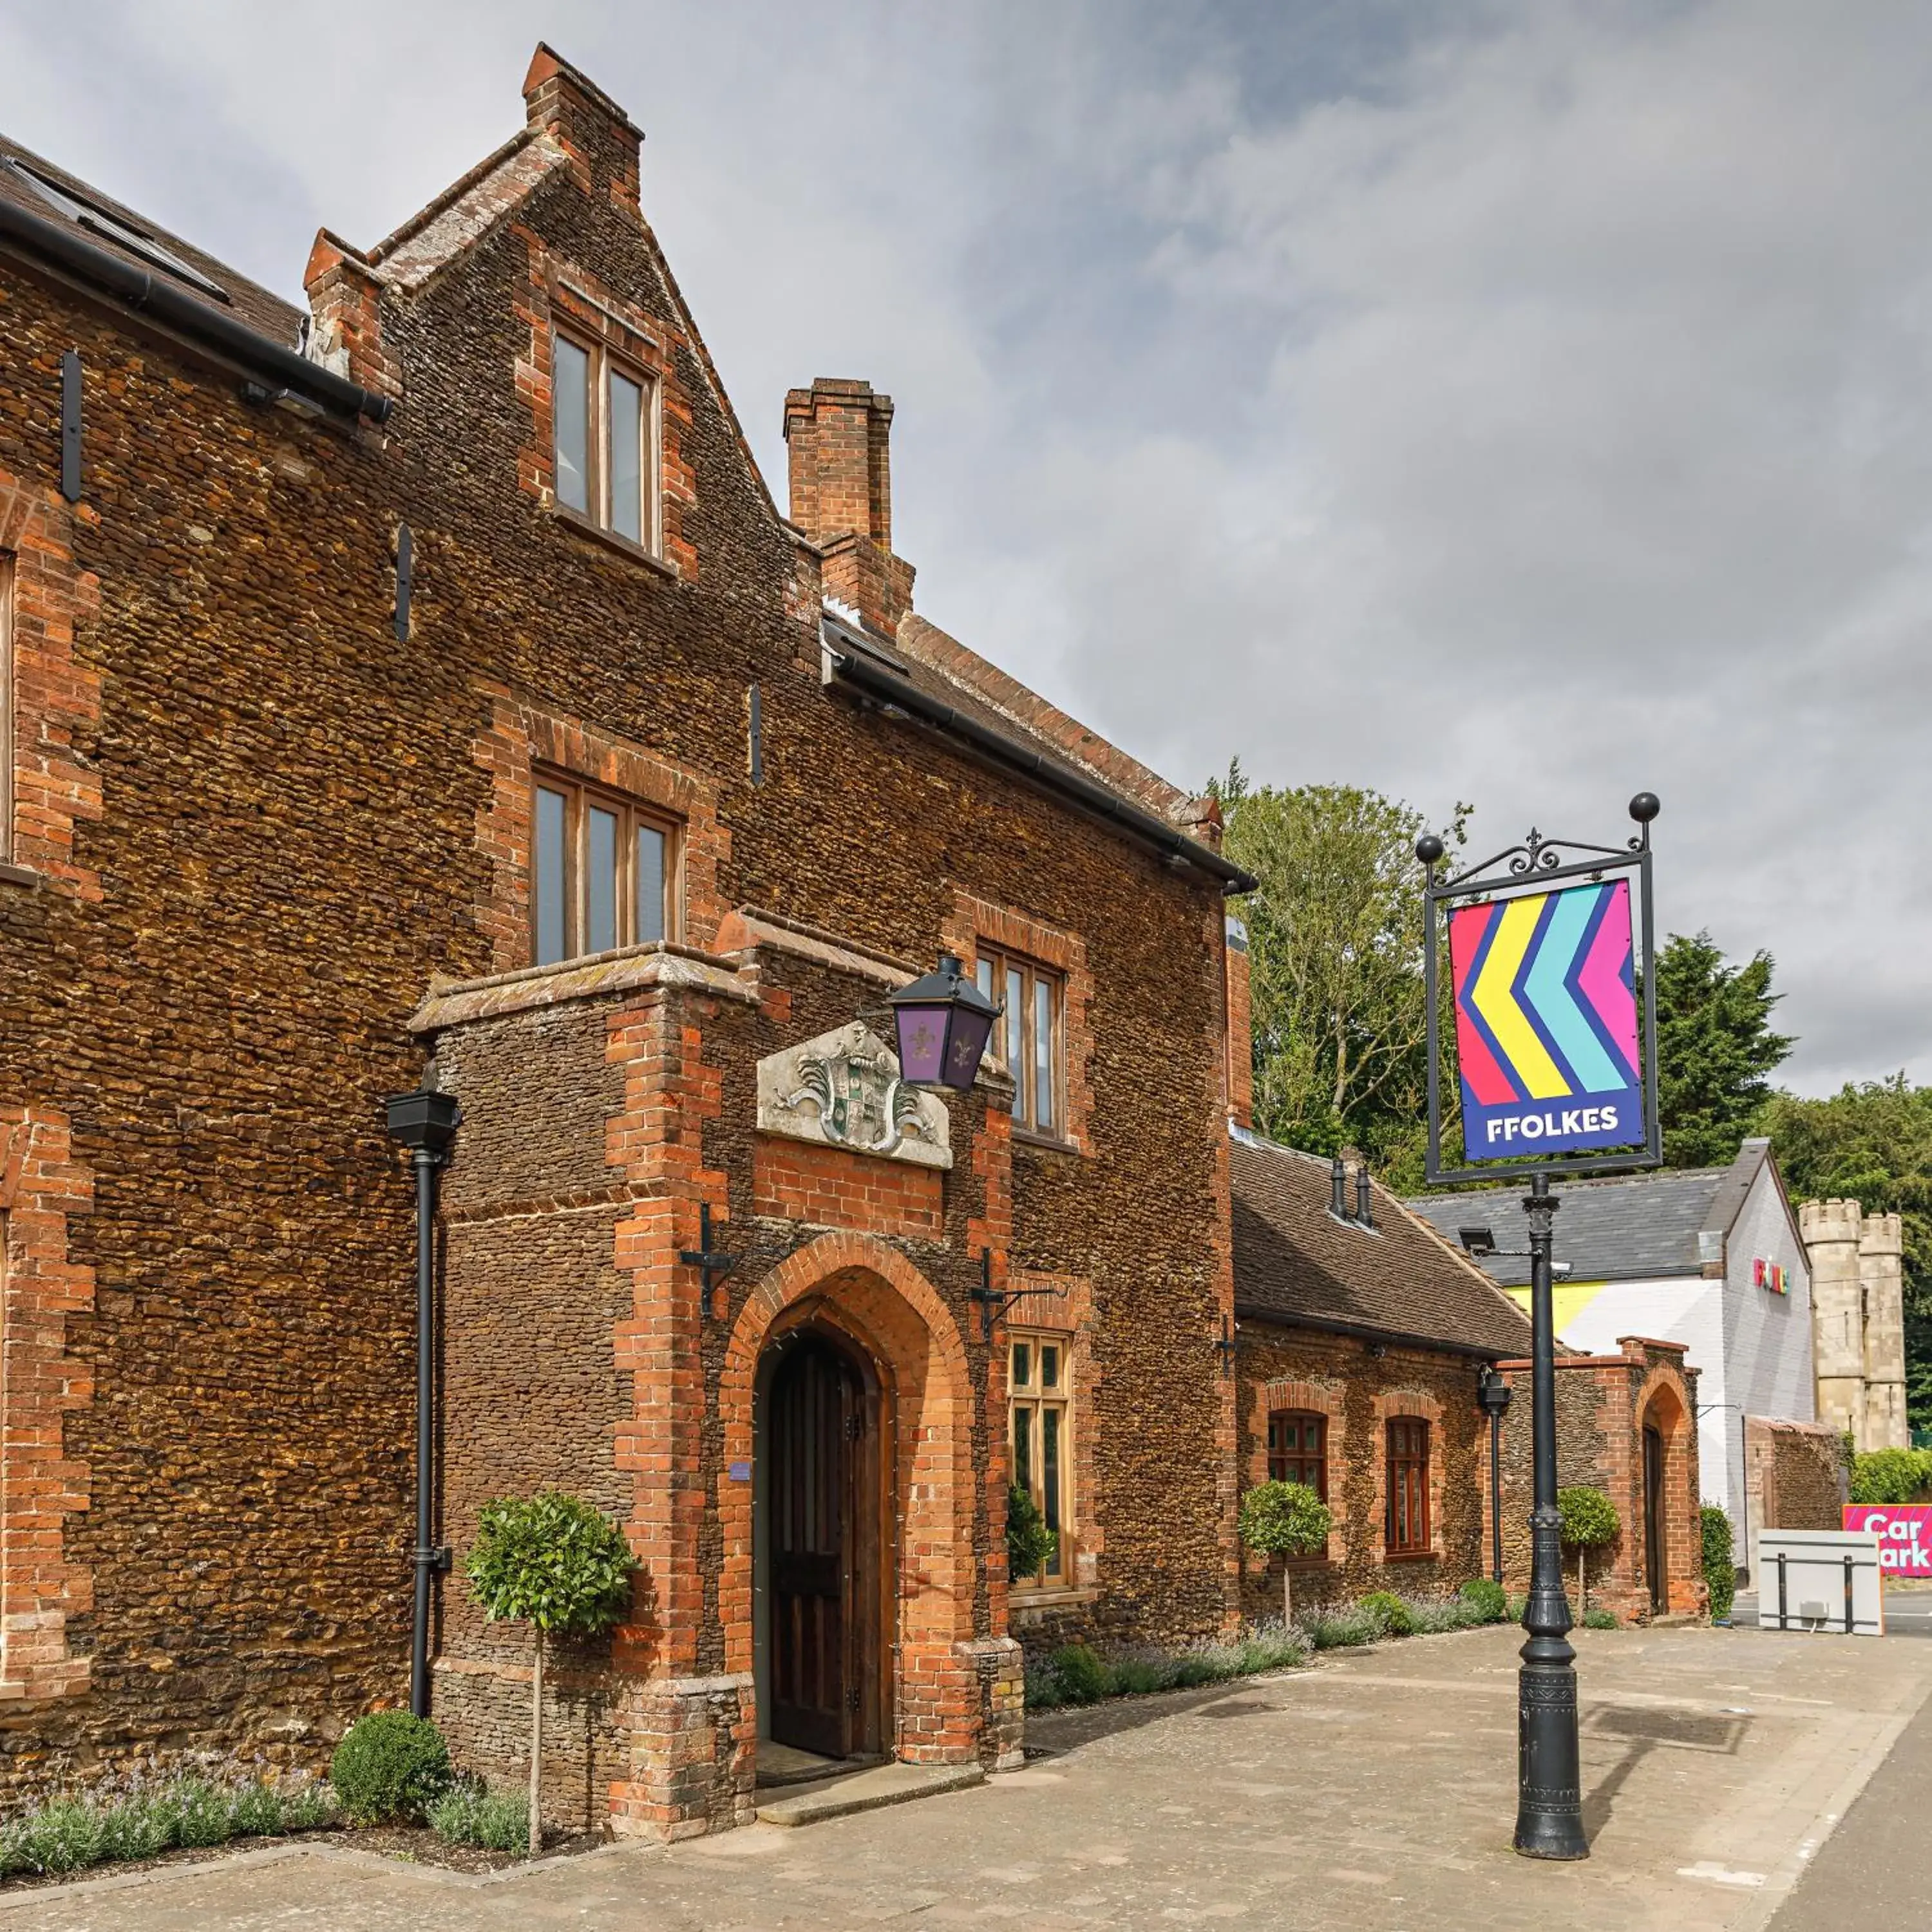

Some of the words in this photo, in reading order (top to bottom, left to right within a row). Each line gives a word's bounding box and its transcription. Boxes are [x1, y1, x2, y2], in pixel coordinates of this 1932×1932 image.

[1487, 1106, 1618, 1143] FFOLKES
[1864, 1514, 1922, 1540] Car
[1880, 1541, 1931, 1567] ark
